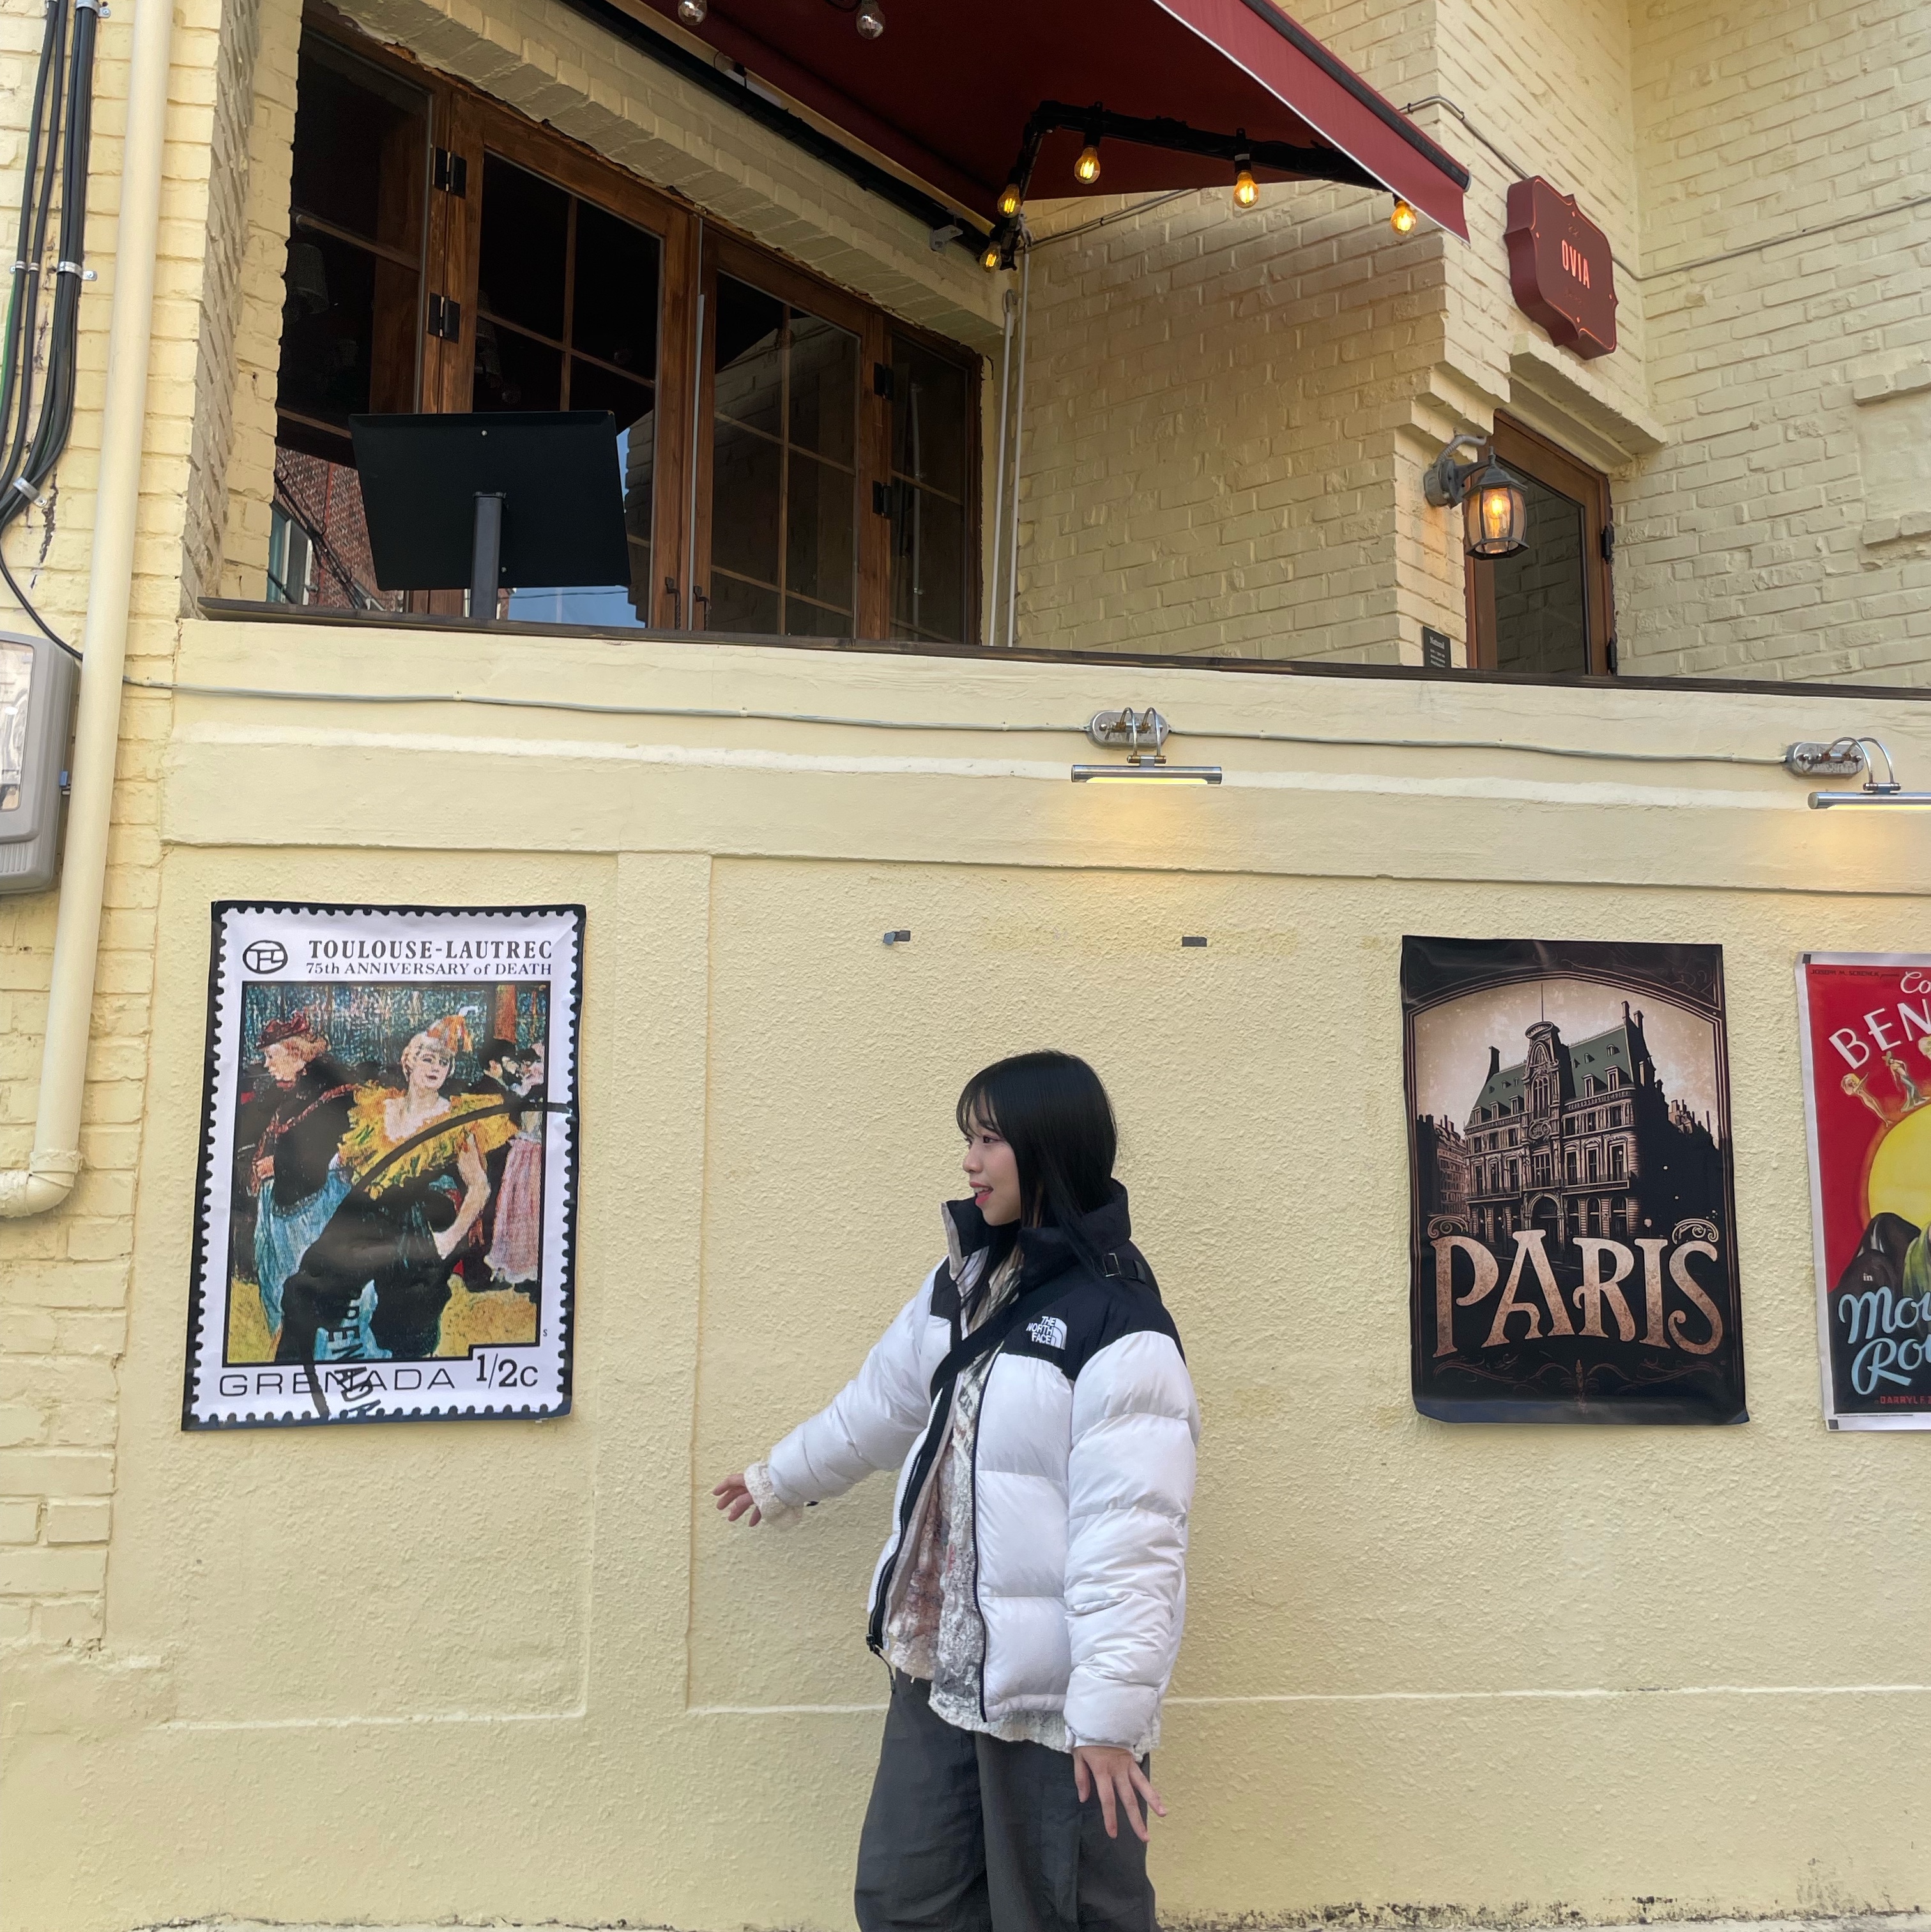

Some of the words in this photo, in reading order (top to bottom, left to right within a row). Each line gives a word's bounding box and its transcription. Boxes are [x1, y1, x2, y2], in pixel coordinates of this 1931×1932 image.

[1561, 239, 1591, 289] OVIA
[309, 939, 552, 959] TOULOUSE-LAUTREC
[306, 962, 340, 975] 75th
[344, 962, 470, 975] ANNIVERSARY
[473, 963, 491, 975] of
[495, 962, 553, 976] DEATH
[1828, 998, 1931, 1070] BEN
[1862, 1272, 1874, 1282] in
[1430, 1229, 1723, 1358] PARIS
[1025, 1322, 1053, 1336] NORTH
[1040, 1315, 1057, 1327] THE
[1031, 1332, 1052, 1344] FACE
[219, 1367, 455, 1396] GRENADA
